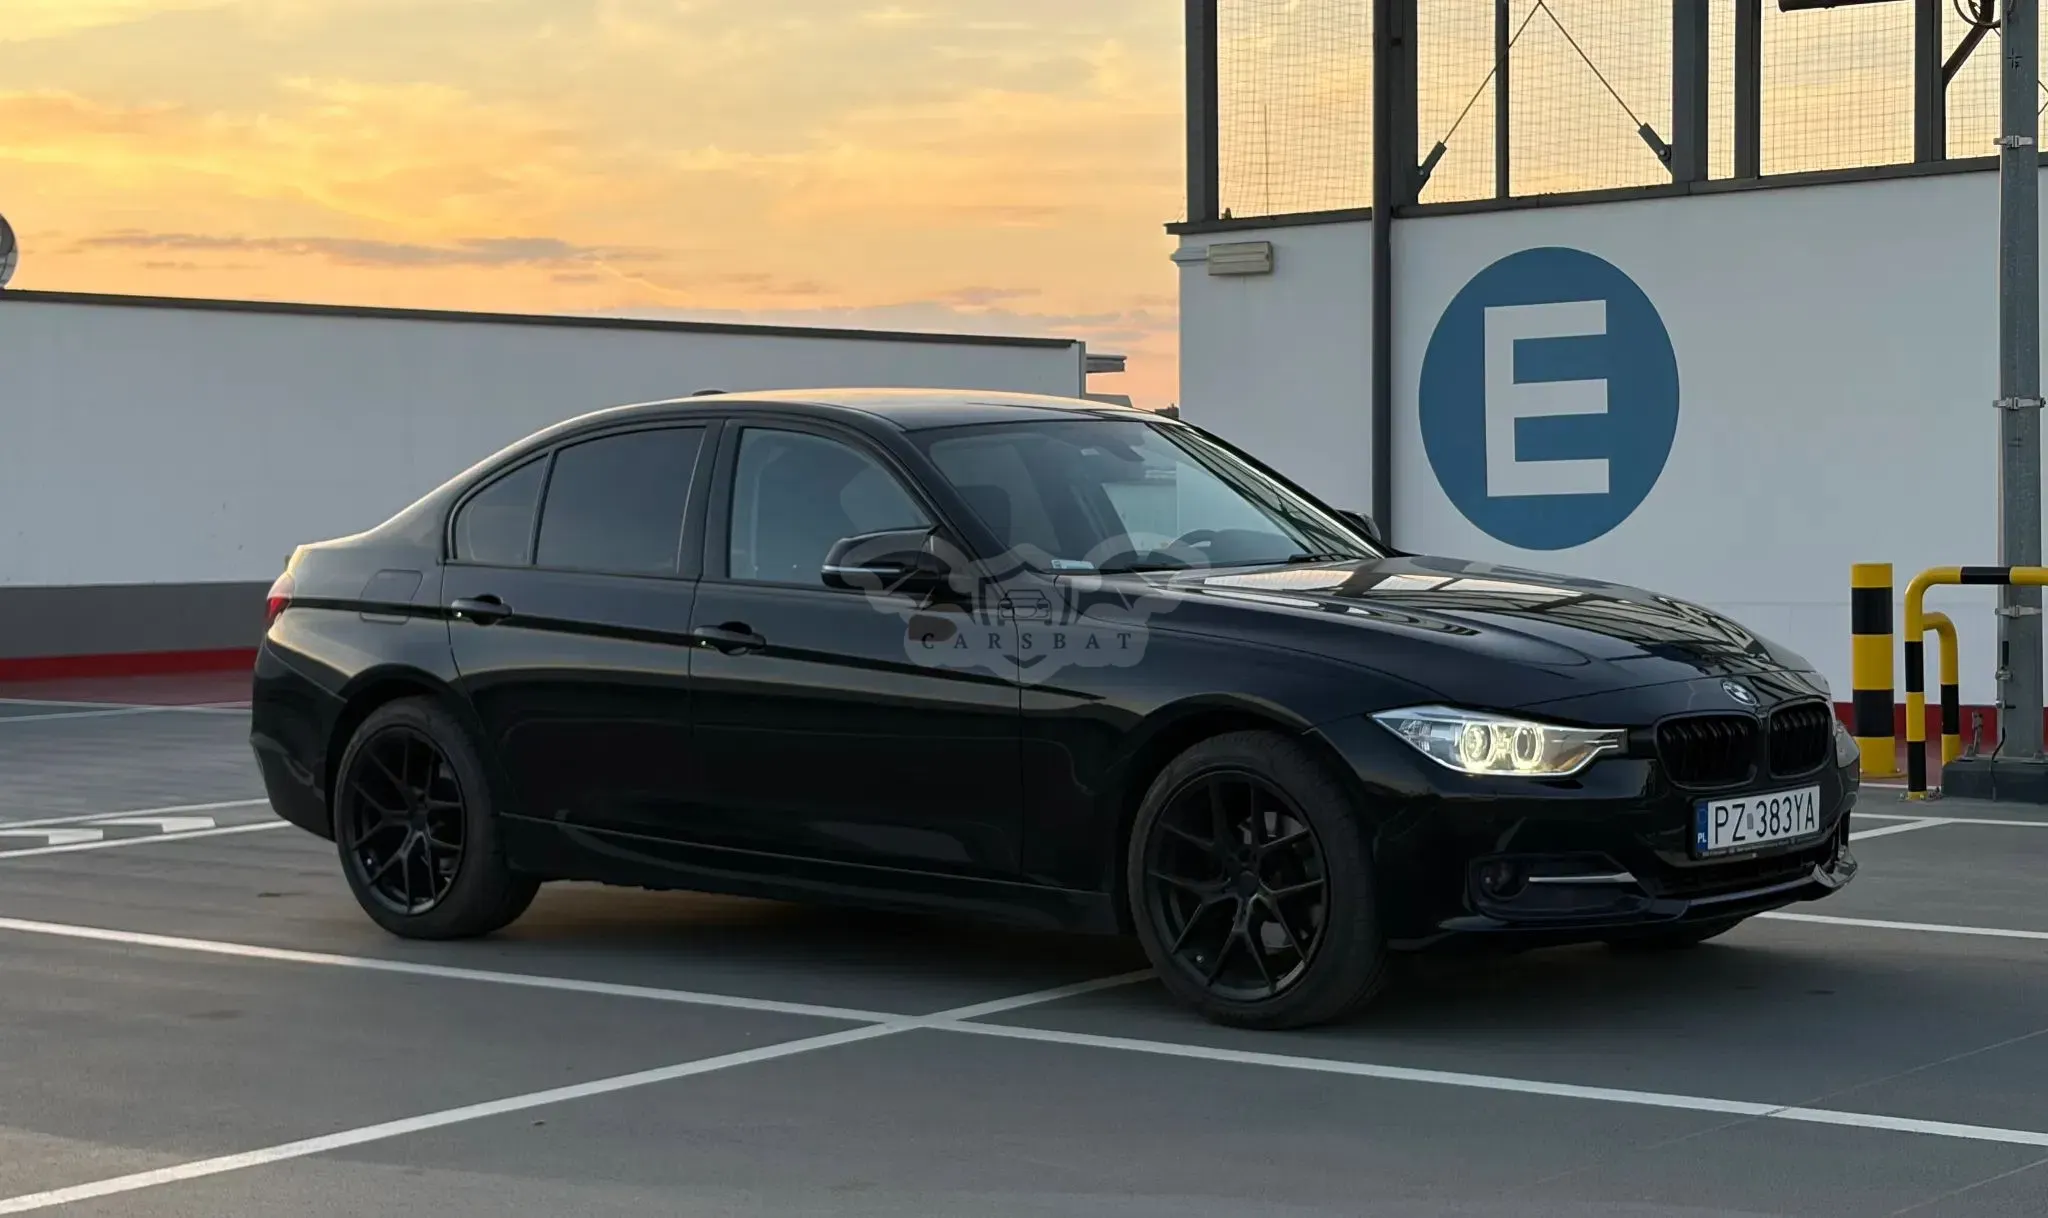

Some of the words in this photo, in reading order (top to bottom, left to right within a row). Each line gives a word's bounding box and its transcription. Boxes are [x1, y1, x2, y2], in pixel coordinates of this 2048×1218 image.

[1484, 299, 1610, 497] E
[1697, 832, 1707, 843] PL
[1714, 803, 1746, 844] PZ
[1756, 791, 1815, 838] 383YA
